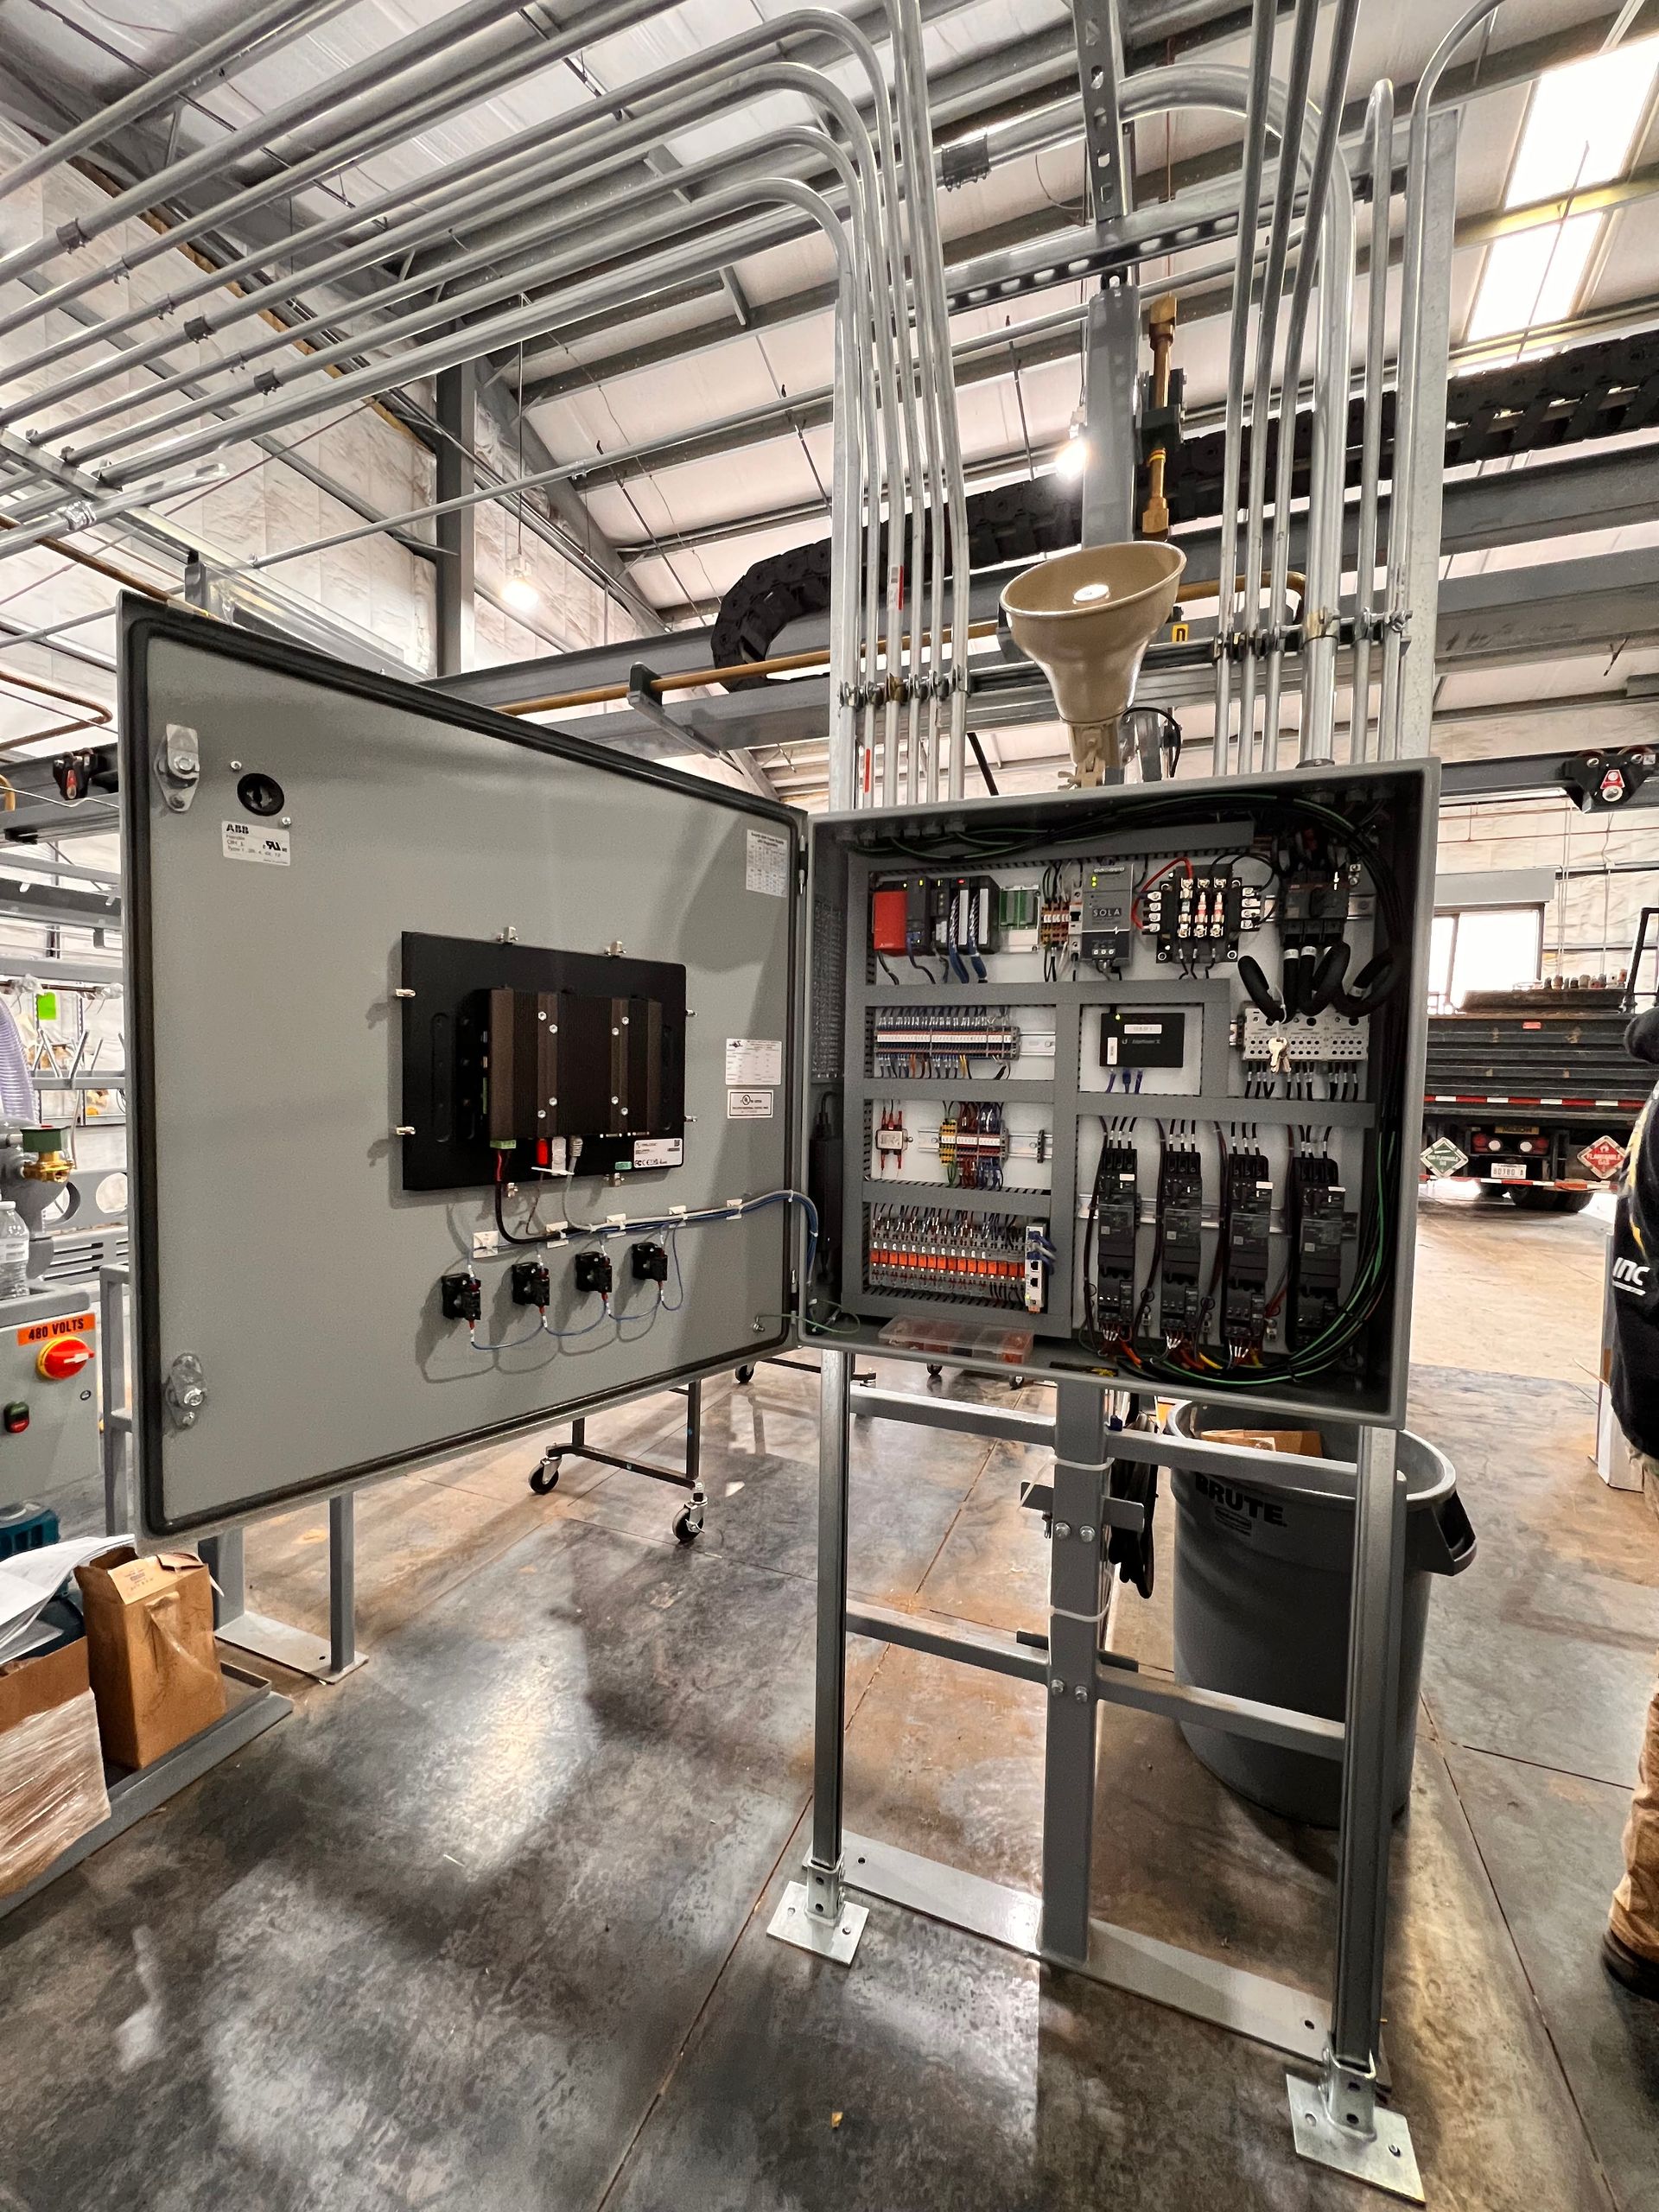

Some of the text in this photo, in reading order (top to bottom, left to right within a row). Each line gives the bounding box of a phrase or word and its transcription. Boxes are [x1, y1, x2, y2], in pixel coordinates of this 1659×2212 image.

[226, 823, 249, 835] ABB
[1093, 908, 1121, 917] SOLA
[29, 1318, 84, 1340] 480 VOLTS
[1195, 1472, 1284, 1527] BRUTE
